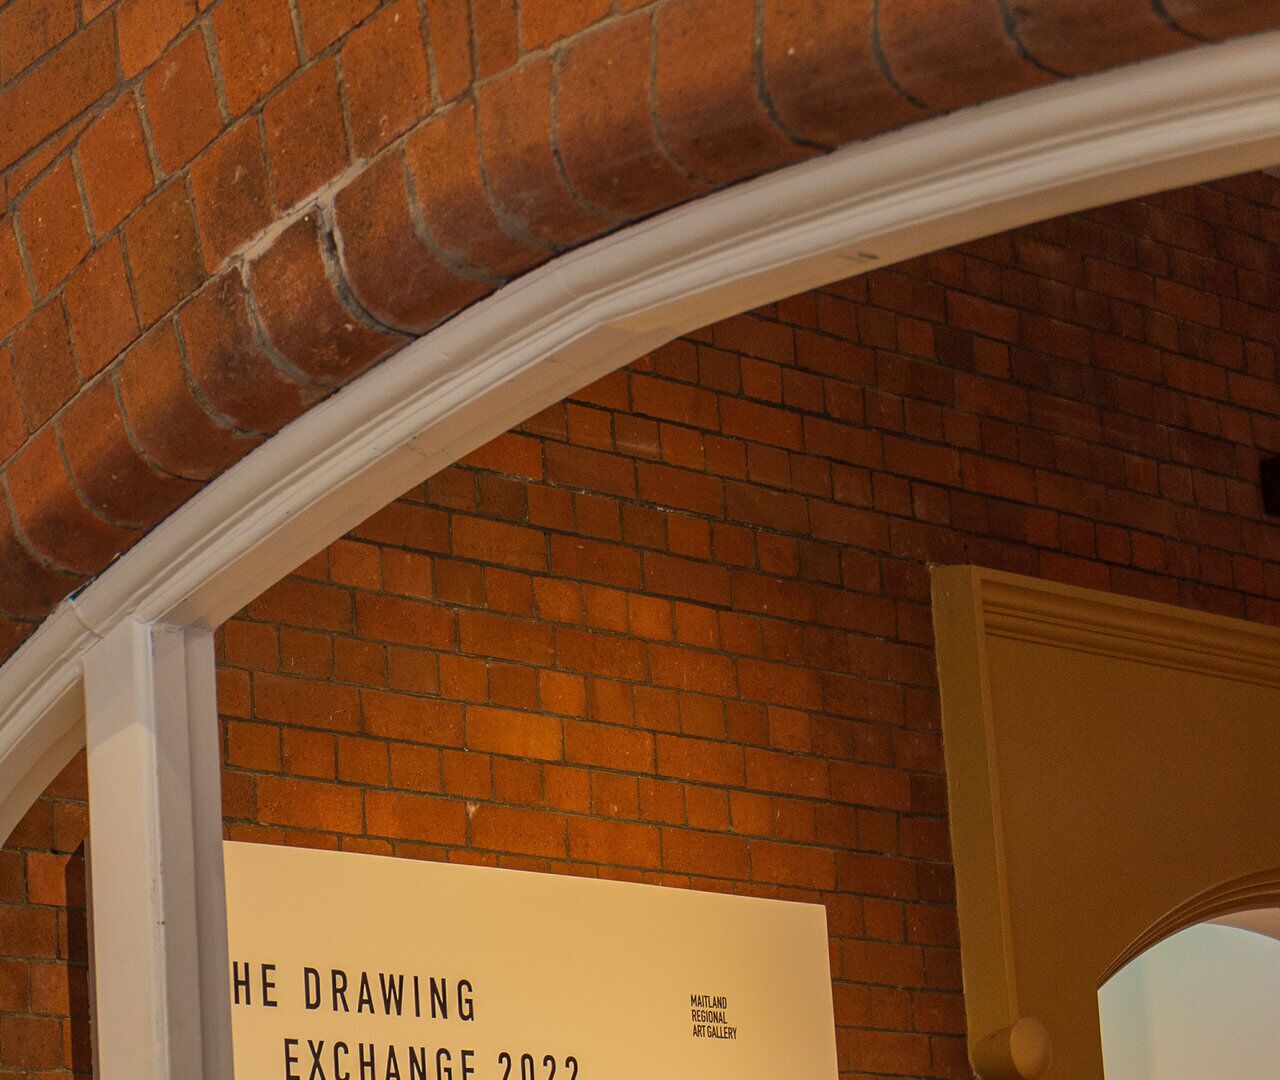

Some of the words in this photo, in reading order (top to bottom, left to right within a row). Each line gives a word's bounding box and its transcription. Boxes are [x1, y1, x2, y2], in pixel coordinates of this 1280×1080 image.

[233, 961, 278, 1007] HE
[304, 967, 474, 1021] DRAWING
[690, 994, 728, 1009] MAITLAND
[691, 1009, 728, 1024] REGIONAL
[692, 1024, 706, 1038] ART
[706, 1025, 737, 1040] GALLERY
